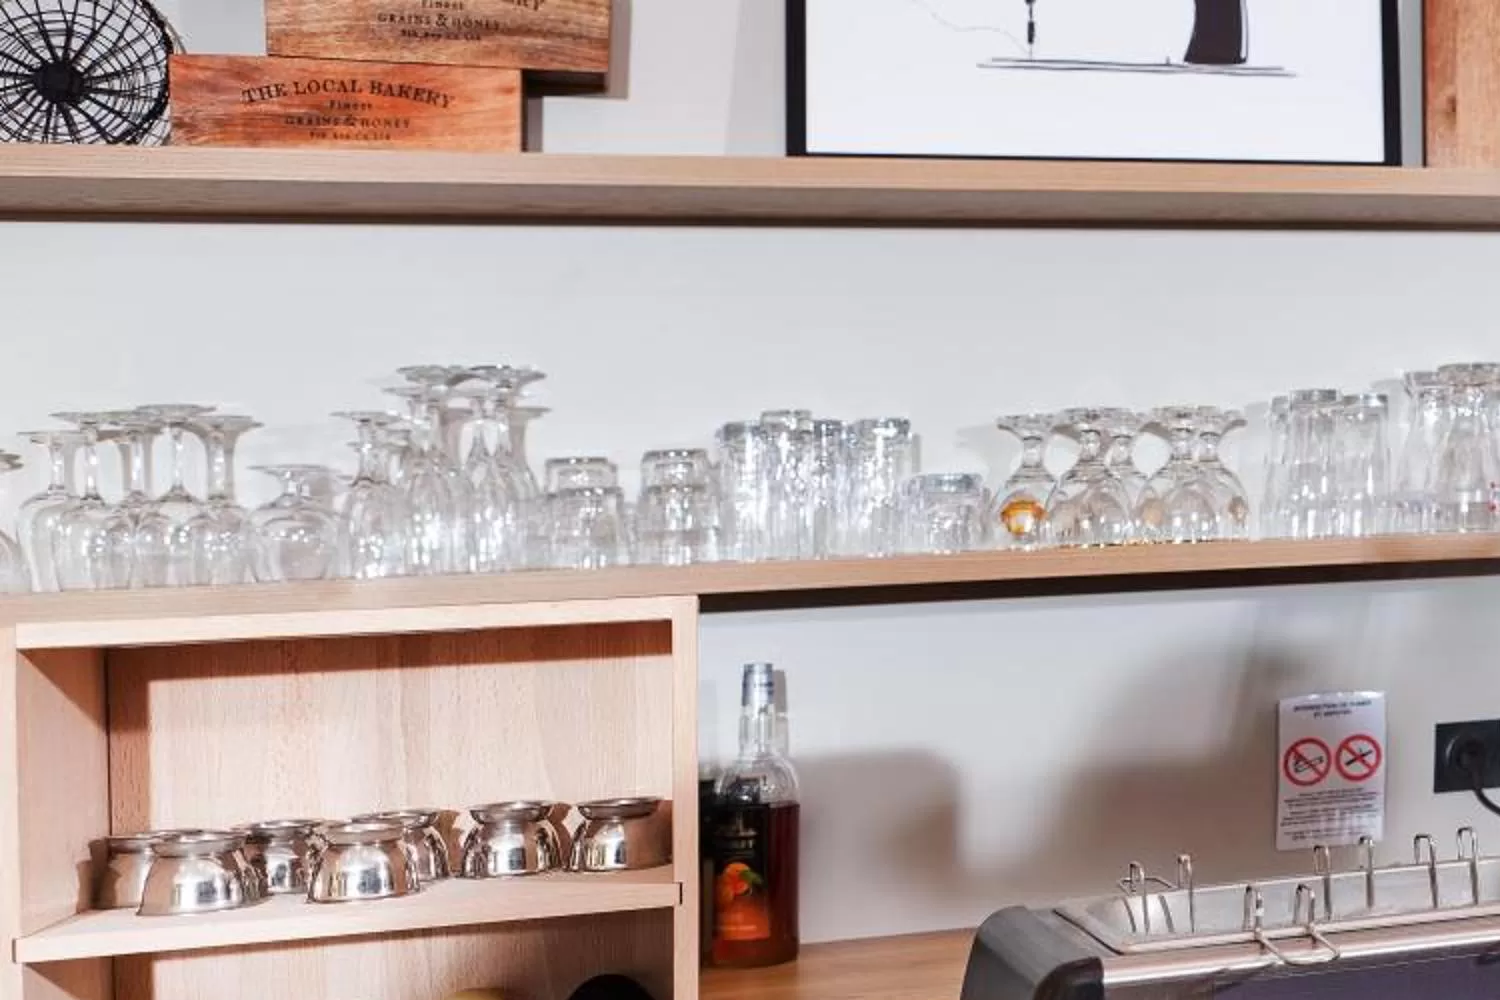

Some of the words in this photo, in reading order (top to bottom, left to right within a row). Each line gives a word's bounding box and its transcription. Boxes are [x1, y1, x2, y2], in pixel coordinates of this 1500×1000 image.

[377, 13, 431, 26] GRAINS
[435, 13, 449, 30] &
[241, 83, 287, 103] THE
[292, 79, 362, 96] LOCAL
[368, 79, 455, 108] BAKERY
[360, 117, 411, 129] HONEY
